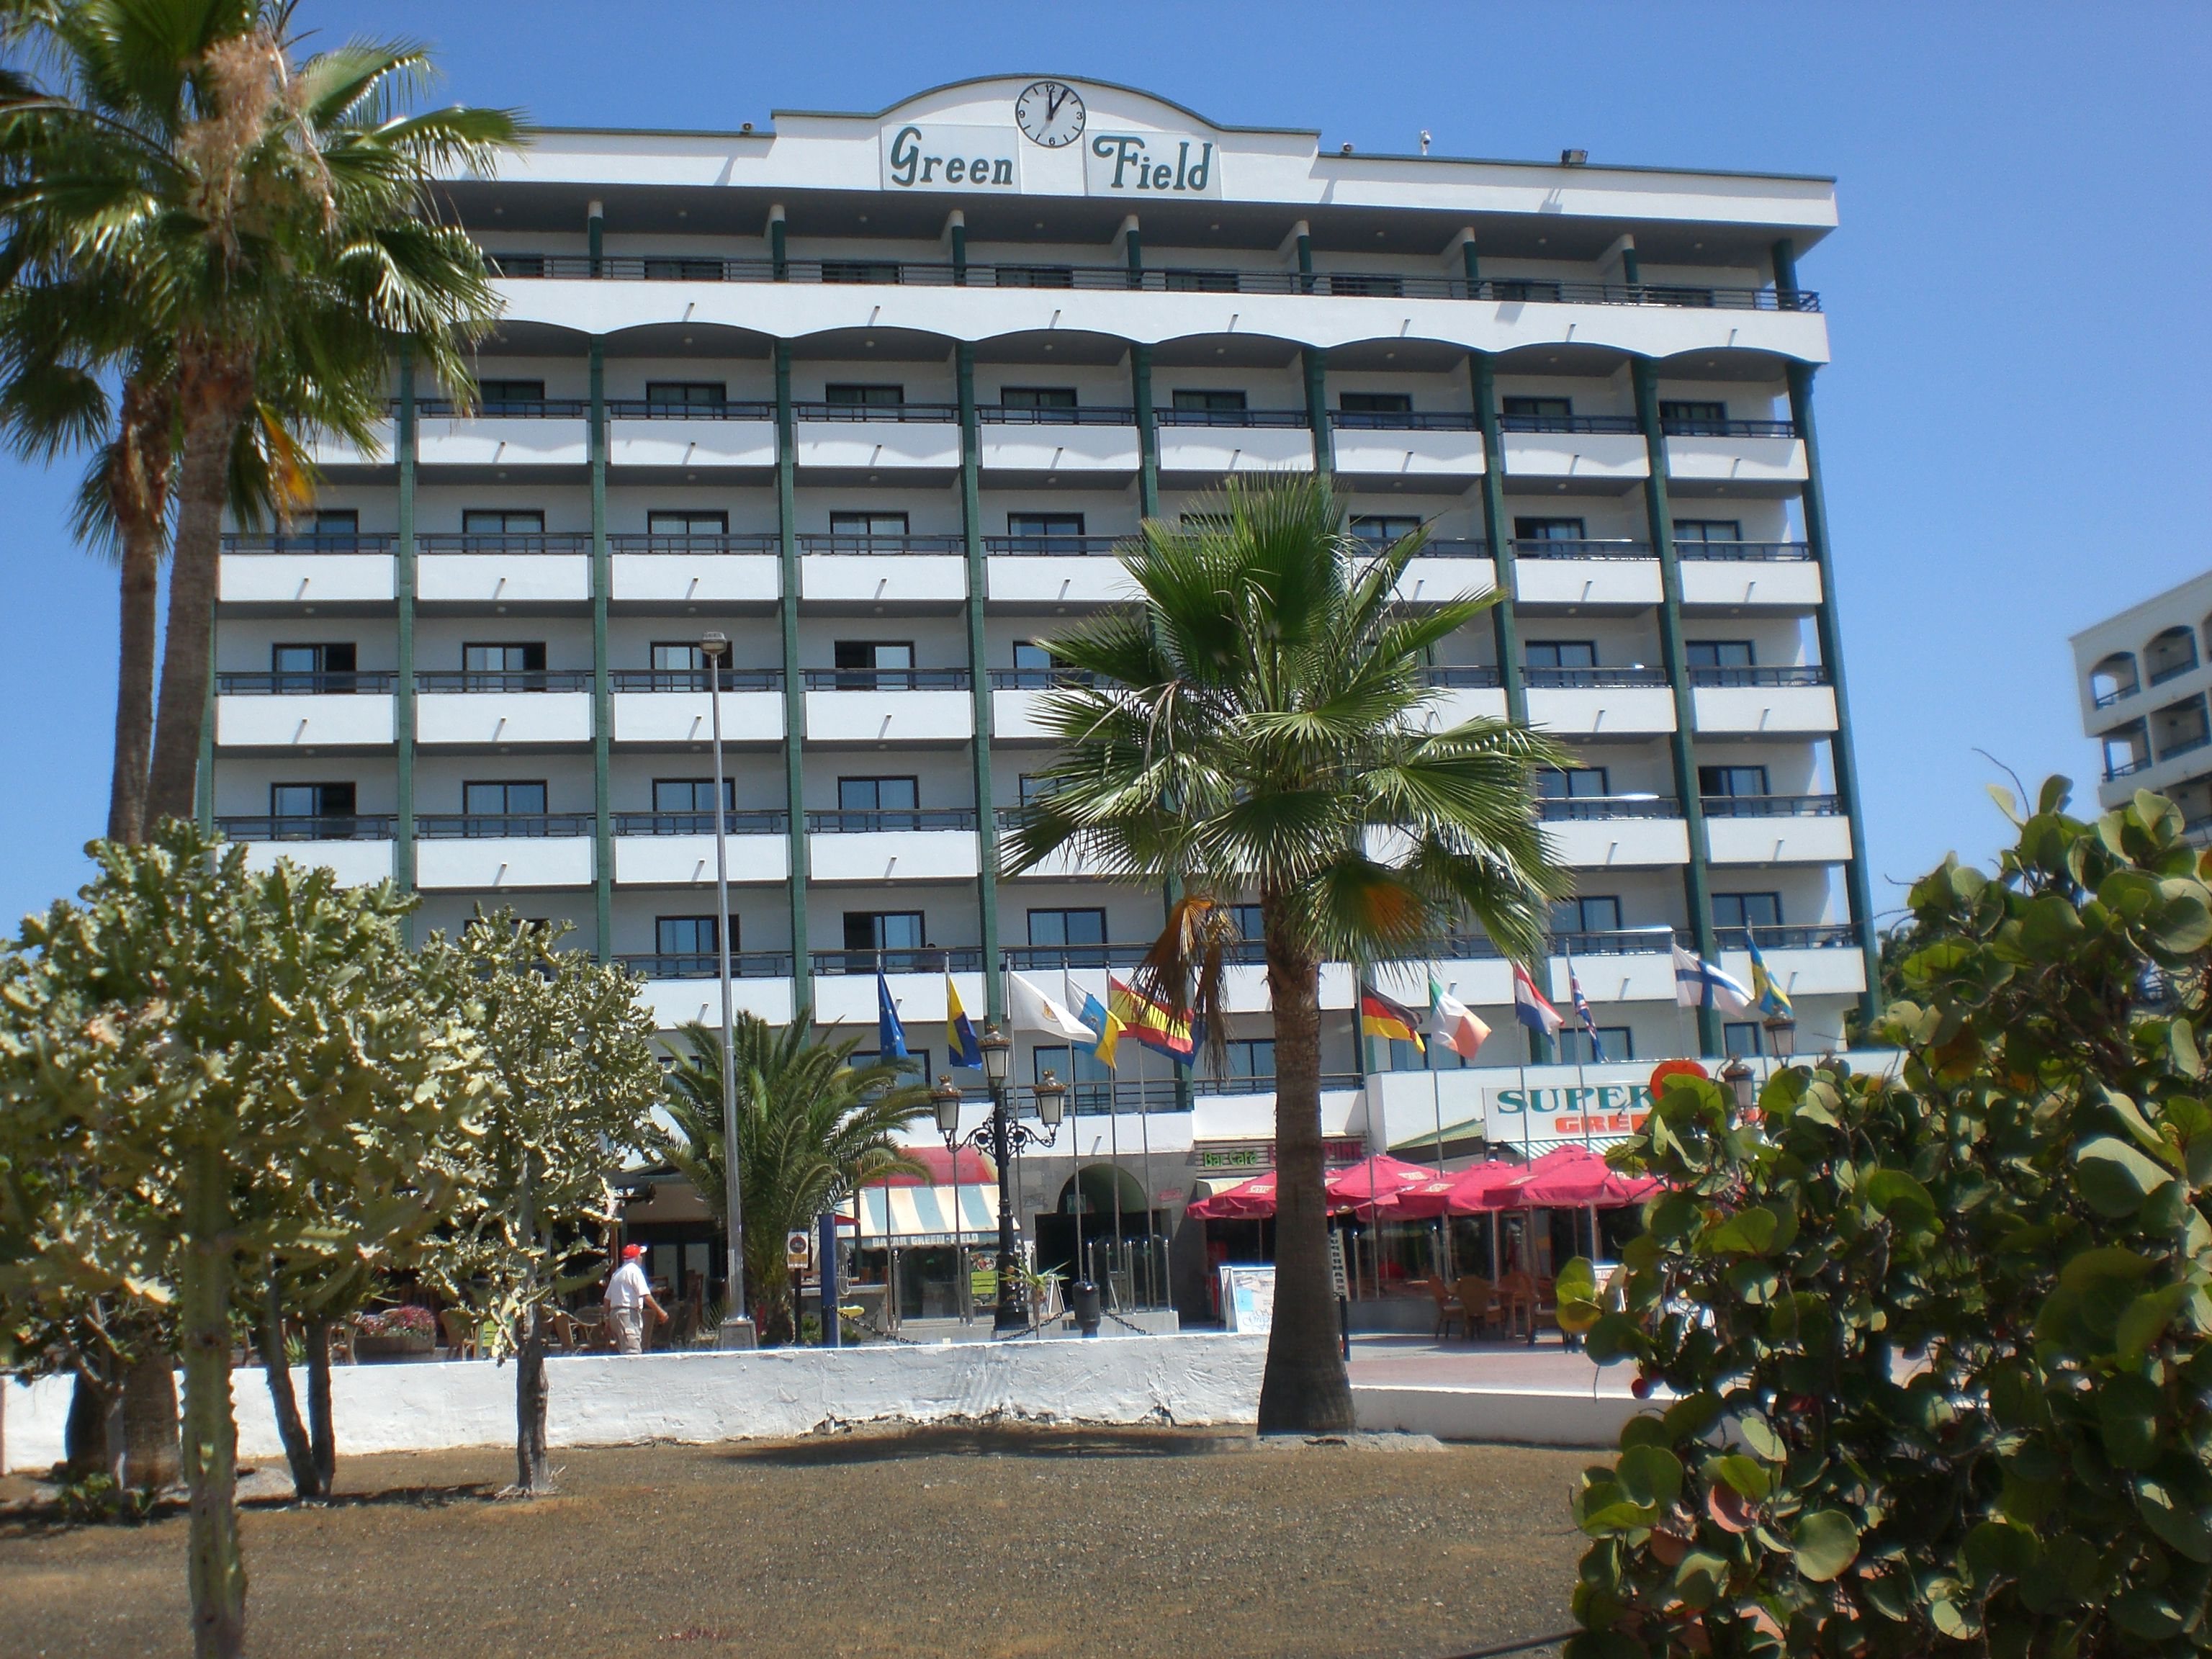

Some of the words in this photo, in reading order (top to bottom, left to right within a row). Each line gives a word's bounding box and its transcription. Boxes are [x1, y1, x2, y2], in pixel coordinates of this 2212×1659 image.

[1045, 84, 1056, 93] 12
[1018, 109, 1026, 119] 9
[1076, 111, 1083, 120] 3
[1048, 137, 1056, 146] 6
[890, 126, 1014, 187] Green
[1092, 135, 1213, 191] Field
[1204, 1152, 1223, 1166] Bar
